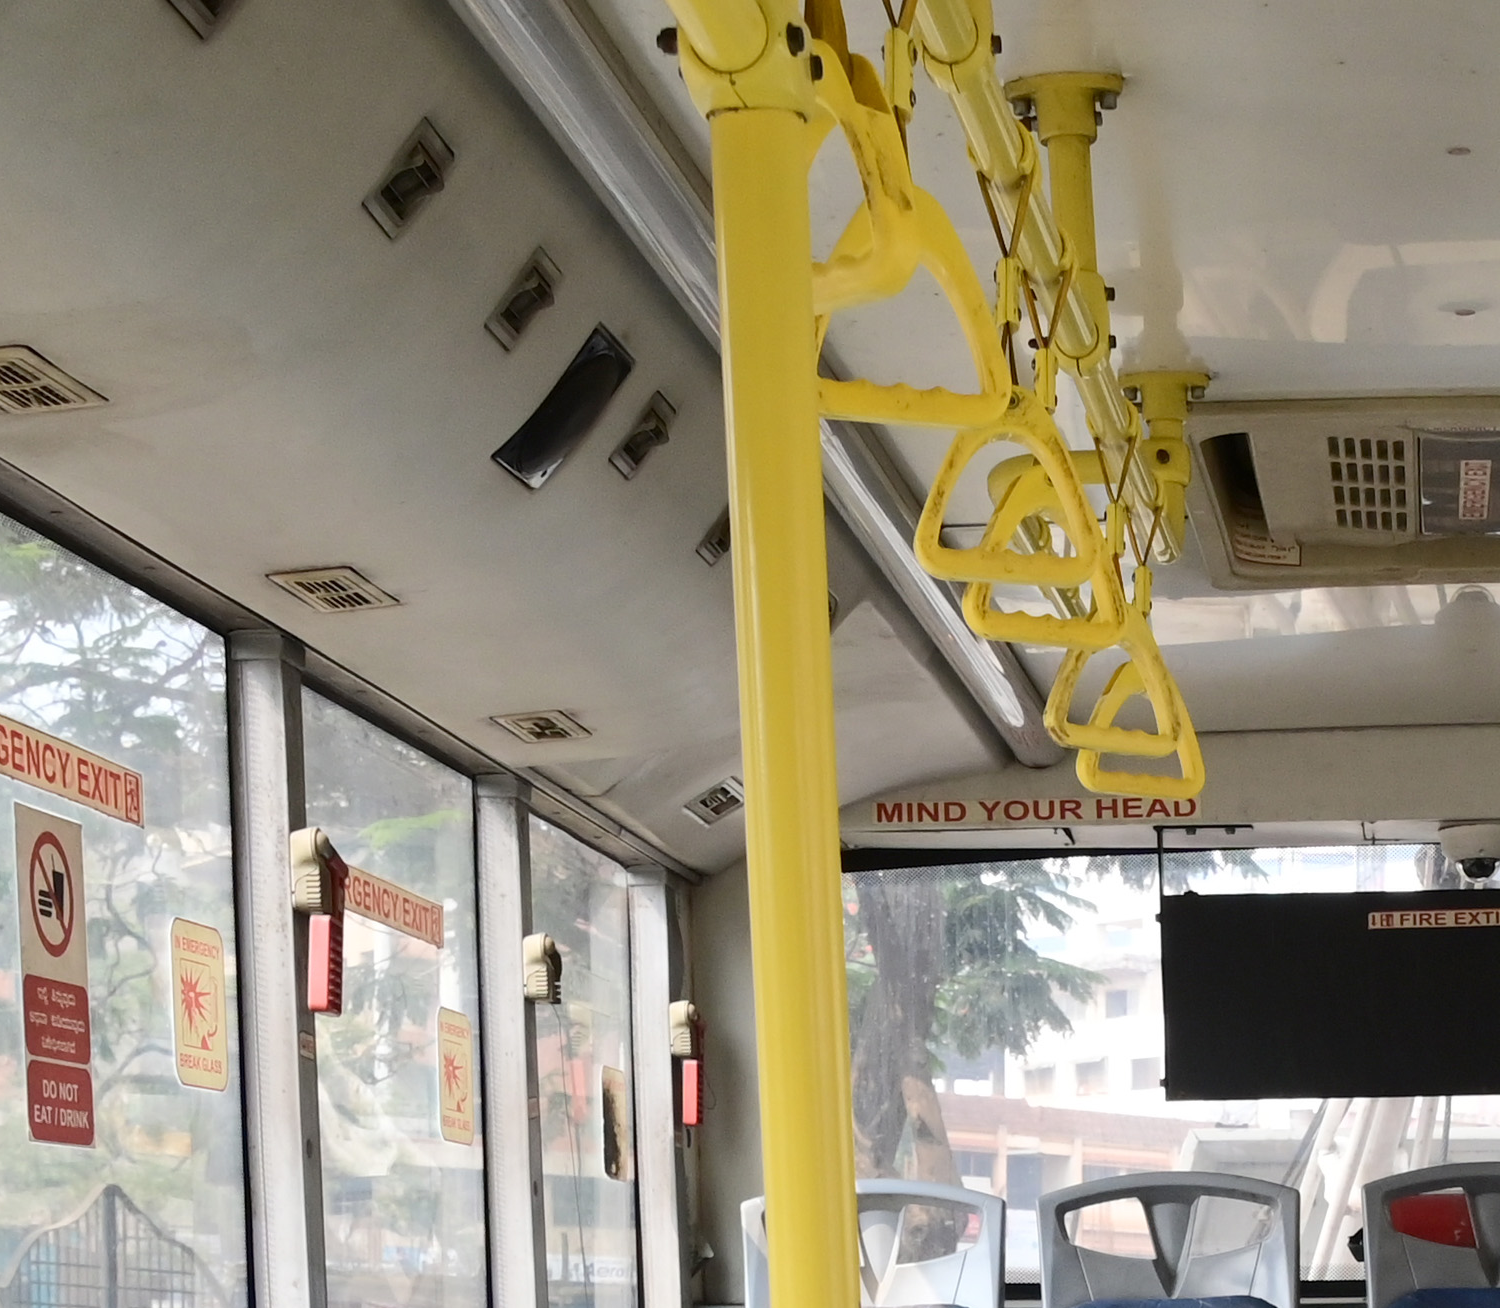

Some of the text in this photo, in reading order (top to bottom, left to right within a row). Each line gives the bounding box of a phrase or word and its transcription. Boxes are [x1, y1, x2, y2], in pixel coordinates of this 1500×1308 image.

[77, 757, 120, 809] EXIT
[876, 797, 1197, 823] MIND YOUR HEAD
[344, 876, 430, 935] RGENCY EXIT
[1399, 912, 1448, 926] FIRE
[182, 936, 220, 960] EMERGENCY
[179, 1052, 222, 1074] BREAK GLASS
[42, 1079, 79, 1102] DO NOT
[33, 1104, 53, 1124] EAT
[60, 1109, 90, 1130] DRINK
